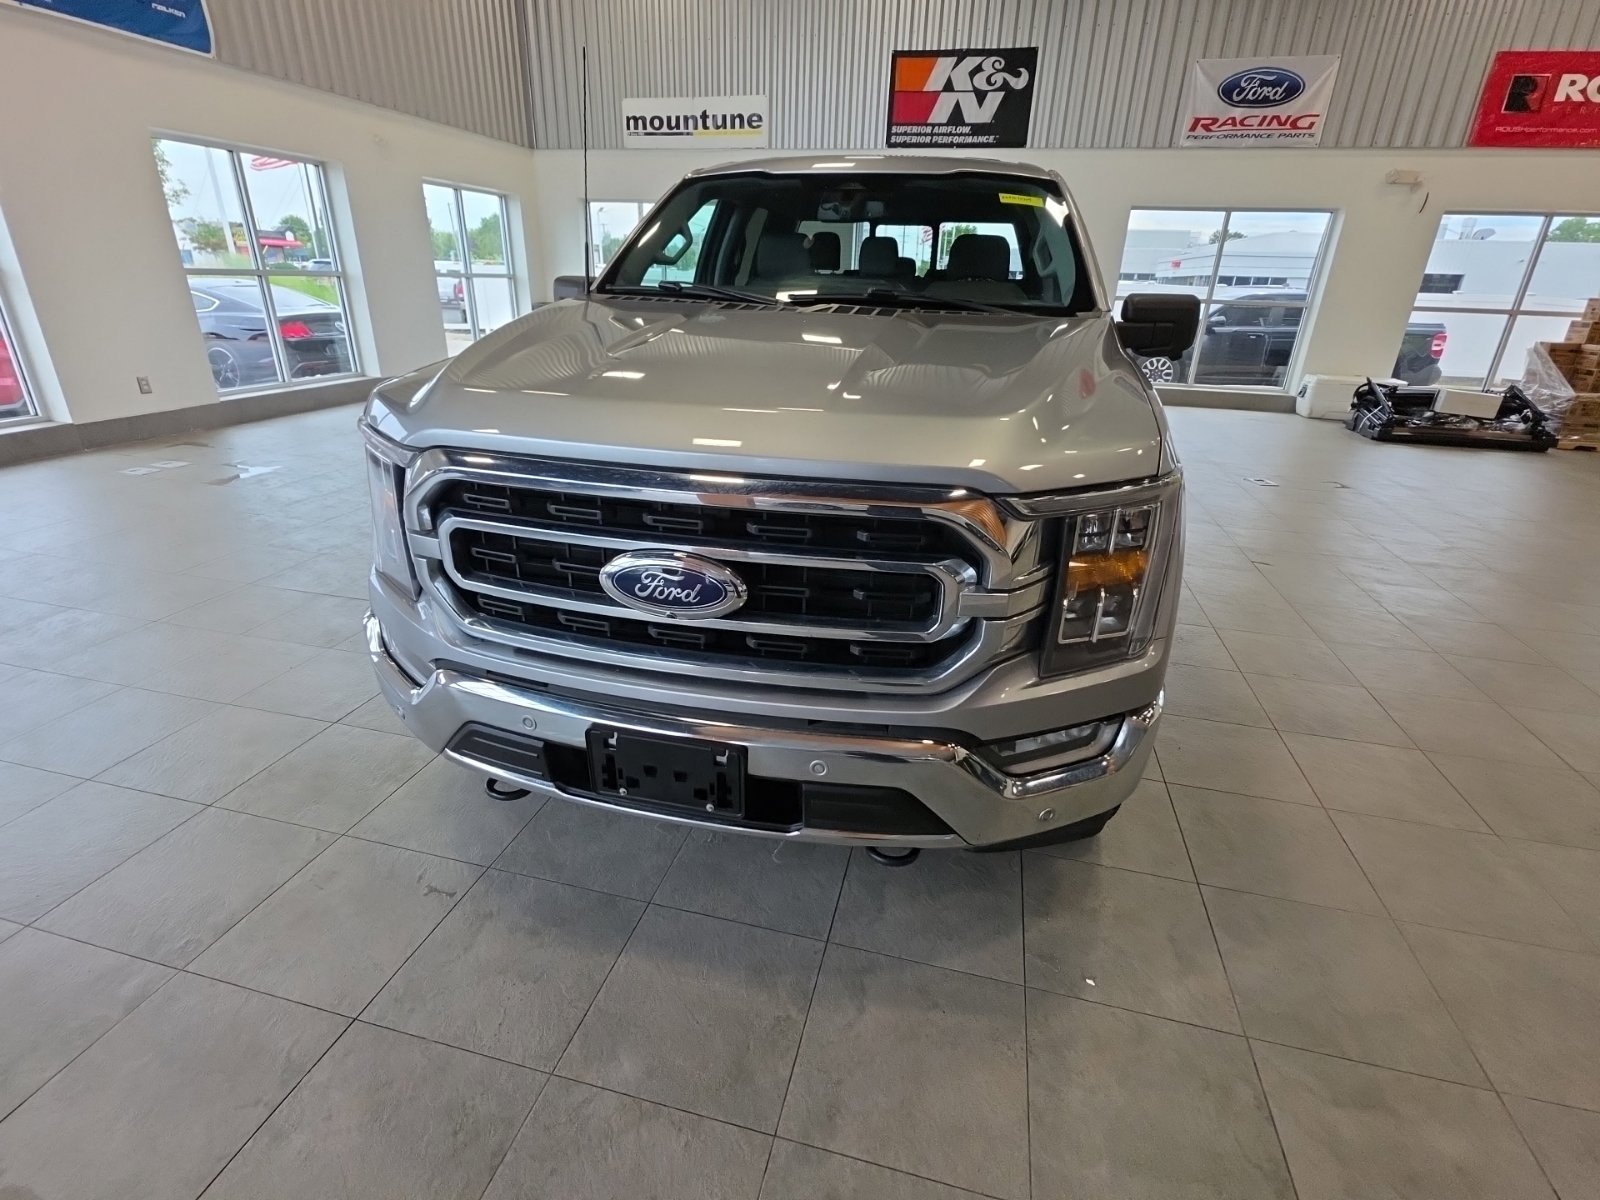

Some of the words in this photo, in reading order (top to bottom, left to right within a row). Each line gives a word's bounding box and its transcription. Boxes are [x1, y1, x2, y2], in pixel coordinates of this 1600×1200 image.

[1232, 74, 1290, 102] Ford
[626, 109, 763, 131] mountune
[933, 126, 972, 134] AIRFLOW.
[1188, 114, 1320, 132] RACING
[890, 135, 931, 143] SUPERIOR
[634, 570, 703, 603] Ford
